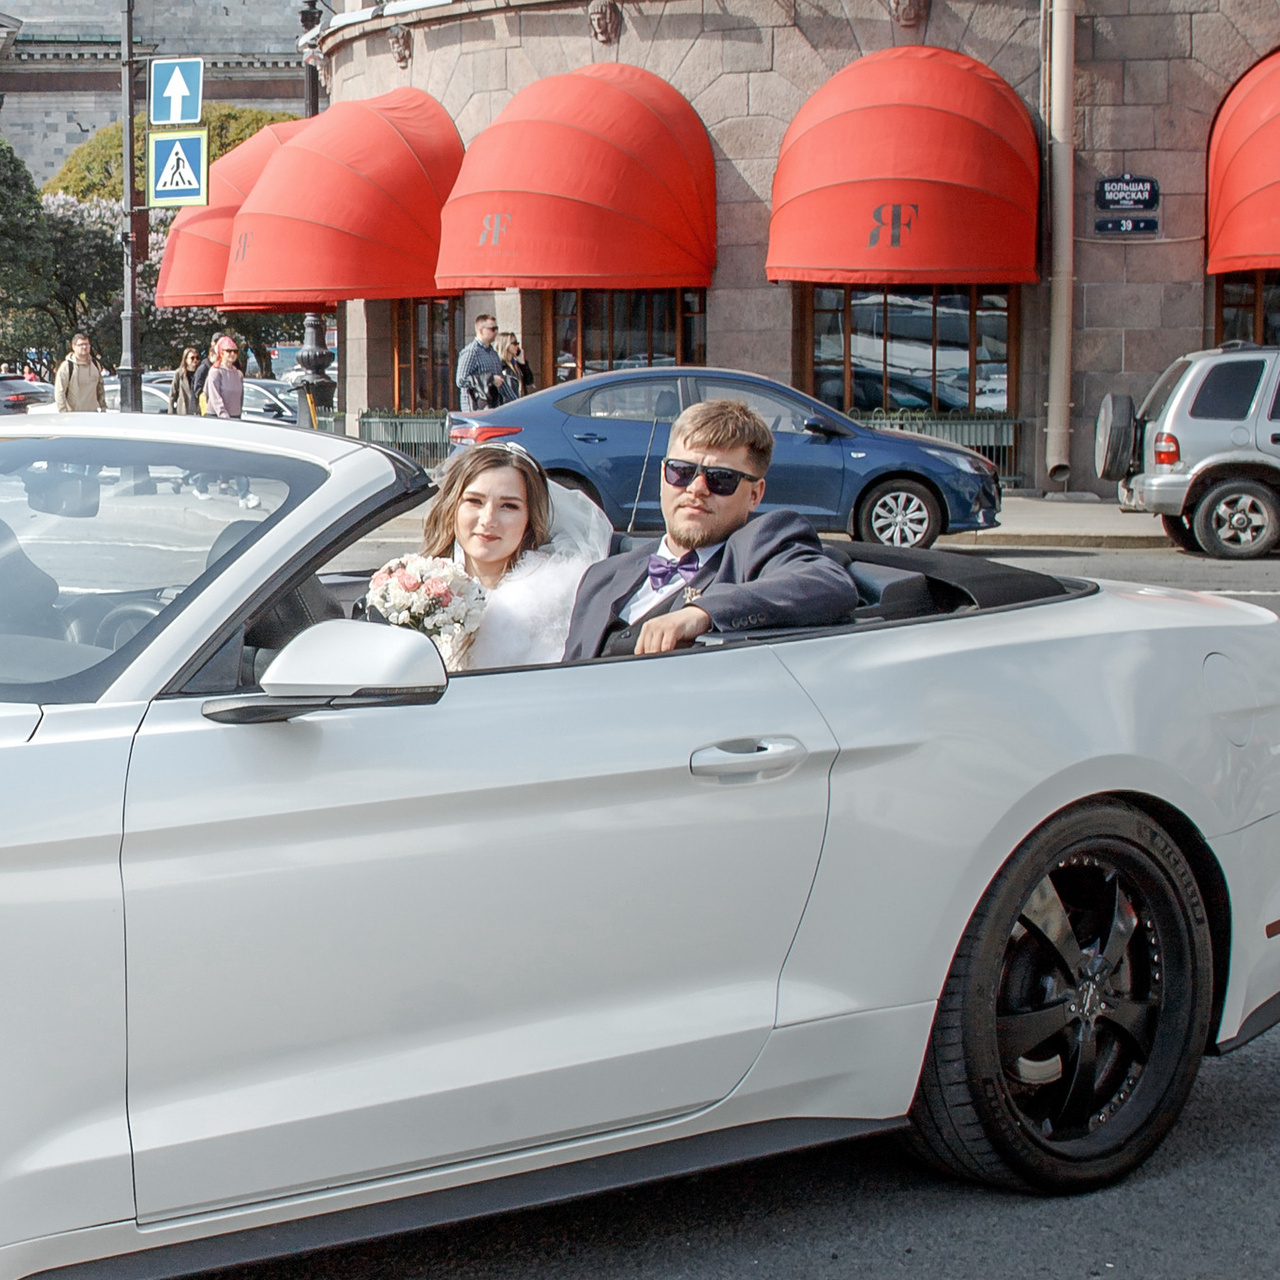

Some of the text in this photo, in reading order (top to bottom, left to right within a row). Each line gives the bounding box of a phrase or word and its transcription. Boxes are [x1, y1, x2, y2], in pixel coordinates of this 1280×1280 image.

[1104, 182, 1151, 191] БОЛЬШАЯ
[1105, 191, 1149, 200] МОРСКАЯ
[1120, 219, 1133, 231] 39
